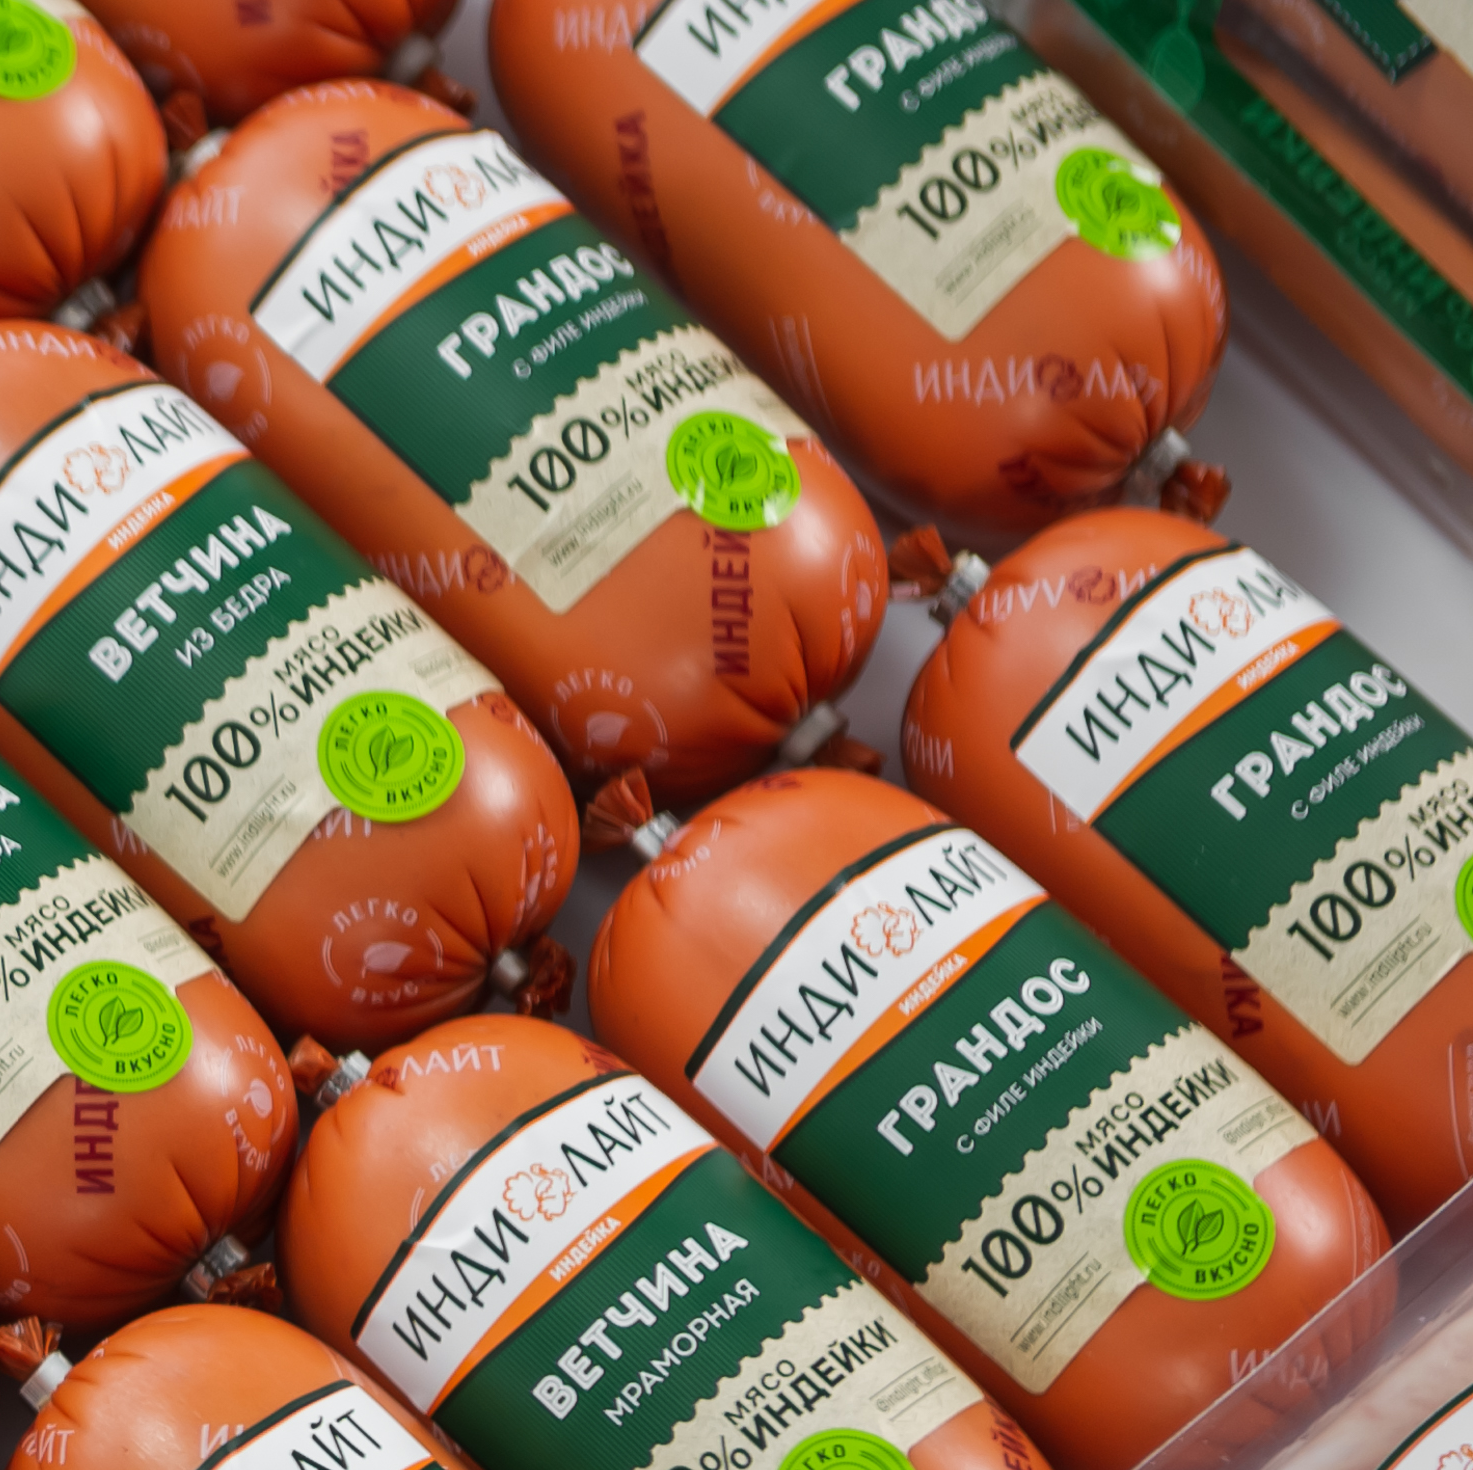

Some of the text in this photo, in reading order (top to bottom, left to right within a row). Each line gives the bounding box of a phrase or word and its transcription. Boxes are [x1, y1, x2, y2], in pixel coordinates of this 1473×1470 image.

[897, 127, 1035, 244] 100%
[437, 244, 635, 379] ГРАНДОС
[508, 402, 649, 513] 100%
[89, 505, 293, 683] ВЕТЧИНА
[176, 565, 292, 669] ИЗ БЕДРА
[296, 608, 428, 713] ИНДЕЙКИ
[1211, 664, 1406, 822] ГРАНДОС
[1288, 834, 1435, 963] 100%
[878, 957, 1091, 1158] ГРАНДОС
[973, 1082, 1027, 1138] ФИЛЕ
[1023, 1017, 1103, 1087] ИНДЕЙКИ
[1093, 1056, 1239, 1181] ИНДЕЙКИ
[962, 1164, 1103, 1298] 100%
[532, 1221, 749, 1420] ВЕТЧИНА
[603, 1278, 760, 1428] МРАМОРНАЯ
[743, 1315, 898, 1450] ИНДЕЙКИ
